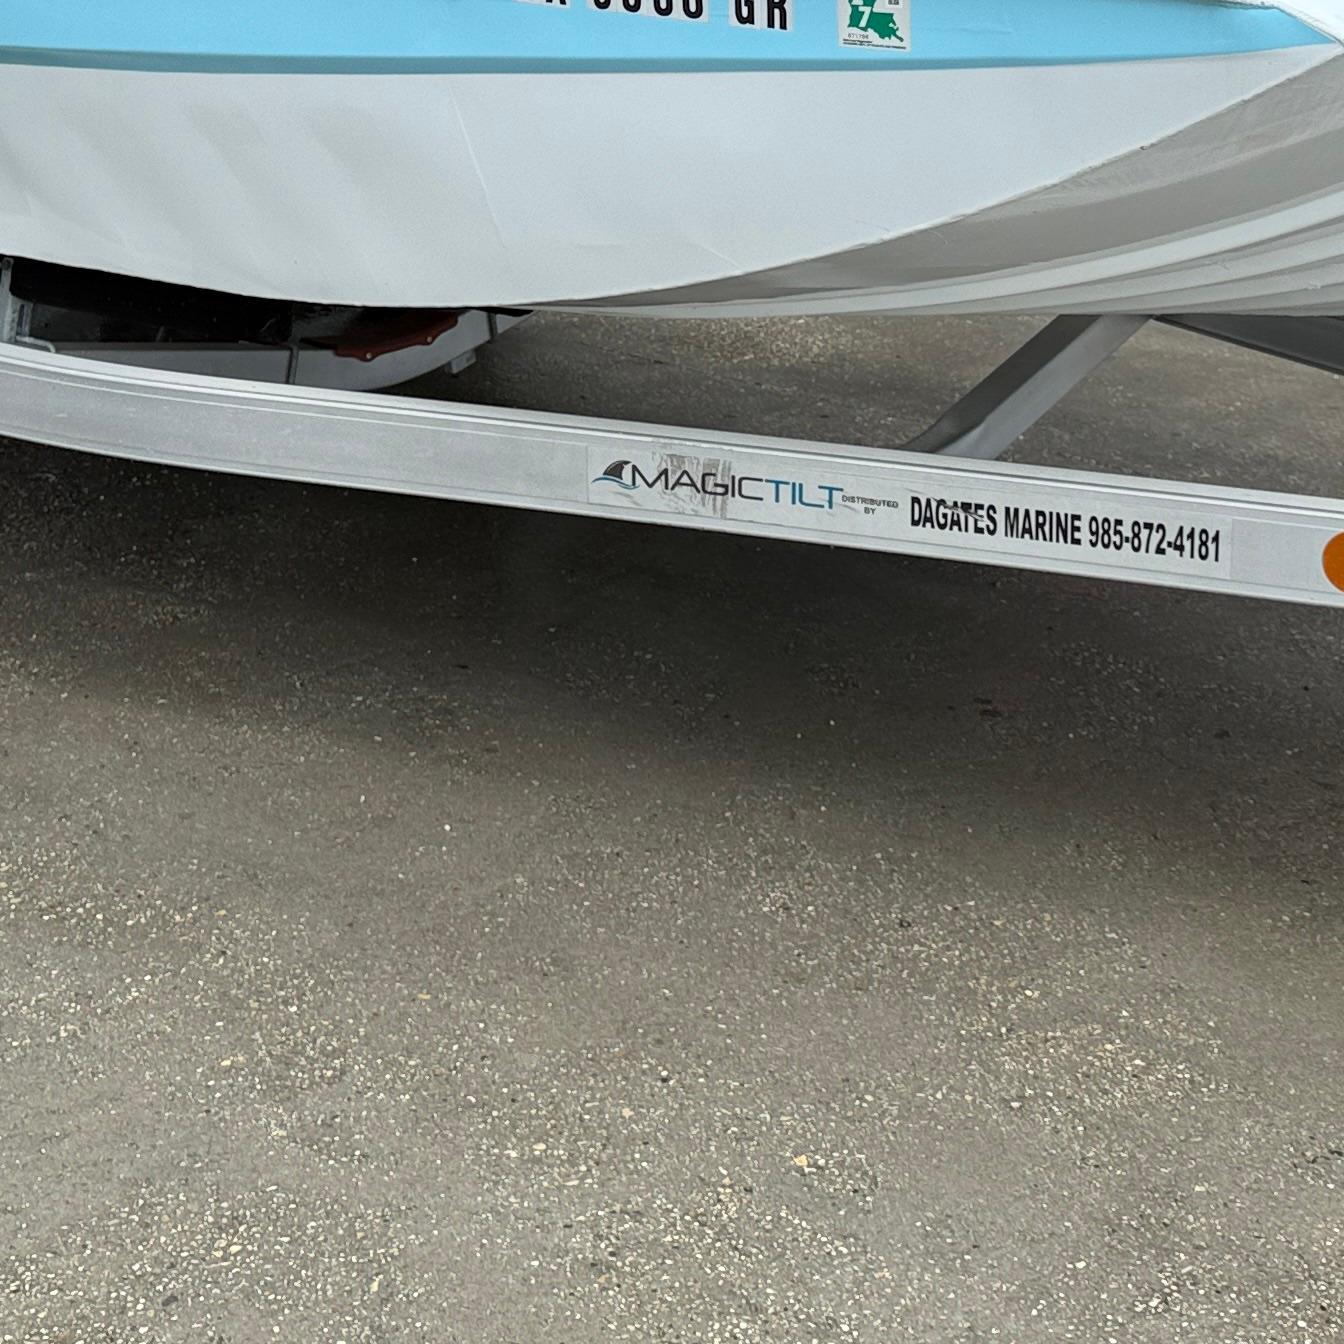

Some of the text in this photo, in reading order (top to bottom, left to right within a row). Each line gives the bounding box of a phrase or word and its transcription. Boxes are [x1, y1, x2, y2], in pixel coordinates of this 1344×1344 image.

[841, 494, 900, 509] DISTRIBUTED
[864, 506, 877, 515] BY
[911, 496, 1221, 563] DAGATES MARINE 985-872-4181
